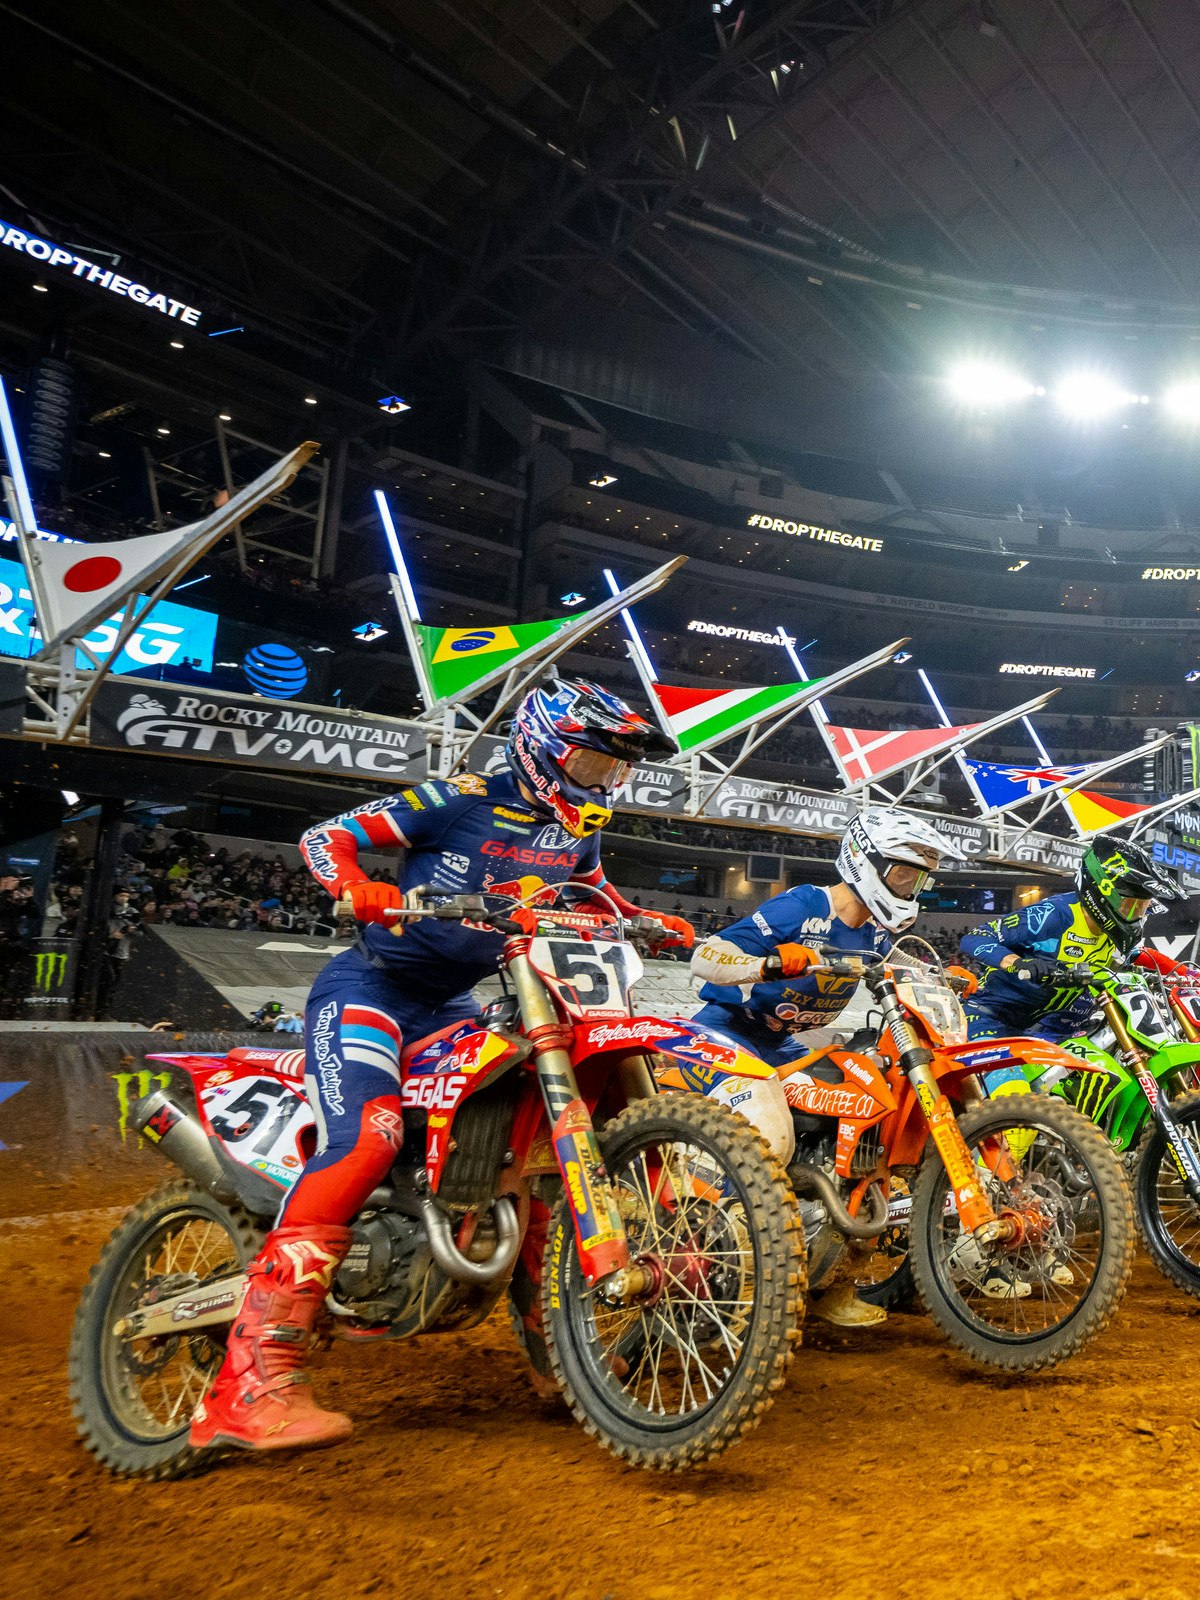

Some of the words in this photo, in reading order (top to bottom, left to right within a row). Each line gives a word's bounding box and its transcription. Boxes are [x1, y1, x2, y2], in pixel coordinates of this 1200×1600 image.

[0, 224, 202, 326] ROPTHEGATE
[747, 514, 884, 552] #DROPTHEGATE
[998, 663, 1096, 679] #DROPTHEGATE
[172, 696, 272, 728] ROCKY
[274, 711, 410, 748] MOUNTAIN
[637, 769, 674, 786] TAIN
[740, 783, 784, 802] ROCKY
[785, 790, 849, 812] MOUNTAIN
[850, 820, 877, 854] OAKLEY
[934, 819, 982, 838] MOUNTAIN
[480, 840, 579, 867] GASGAS
[1051, 840, 1085, 855] MOUNTAI
[1067, 932, 1098, 945] Kawasaki
[717, 951, 758, 965] RACI
[547, 940, 628, 1008] 51
[781, 987, 813, 1005] FLY
[813, 998, 849, 1009] RACIN
[588, 1010, 625, 1018] GASGAS
[402, 1076, 467, 1109] SGAS
[732, 1092, 752, 1106] DST
[812, 1087, 858, 1115] COFFEE
[855, 1094, 875, 1118] CO
[209, 1079, 309, 1157] 51
[840, 1123, 856, 1136] EBC
[1163, 1121, 1198, 1181] DUNLOP
[265, 1164, 301, 1181] MOTOR
[888, 1207, 912, 1217] NTHA
[552, 1224, 565, 1309] DUNLOP
